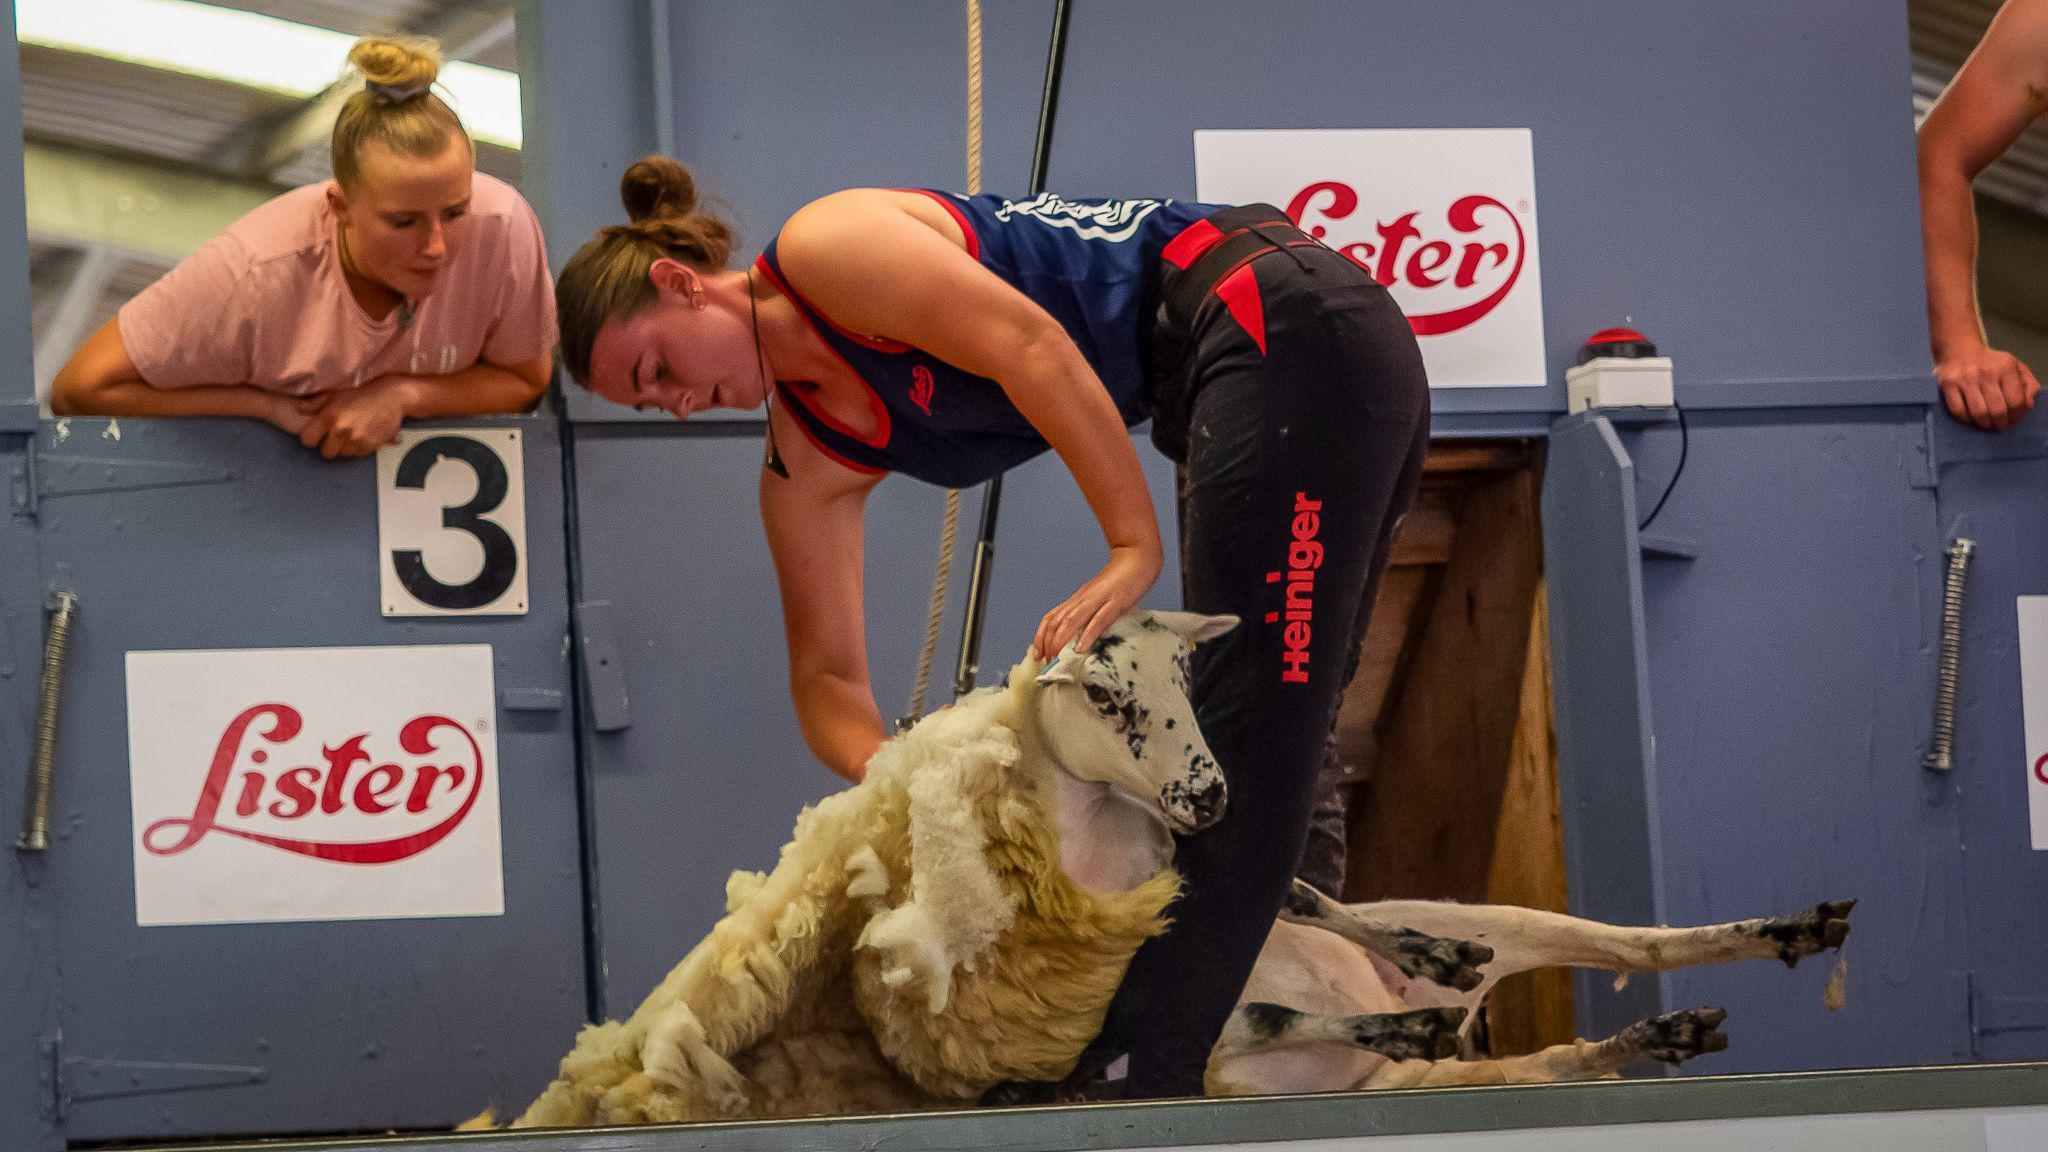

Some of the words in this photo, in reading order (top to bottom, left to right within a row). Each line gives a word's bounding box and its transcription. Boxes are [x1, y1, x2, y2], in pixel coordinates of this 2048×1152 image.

[1285, 181, 1525, 336] ster
[391, 435, 517, 609] 3
[1265, 491, 1325, 684] Heiniger
[142, 702, 484, 865] Lister
